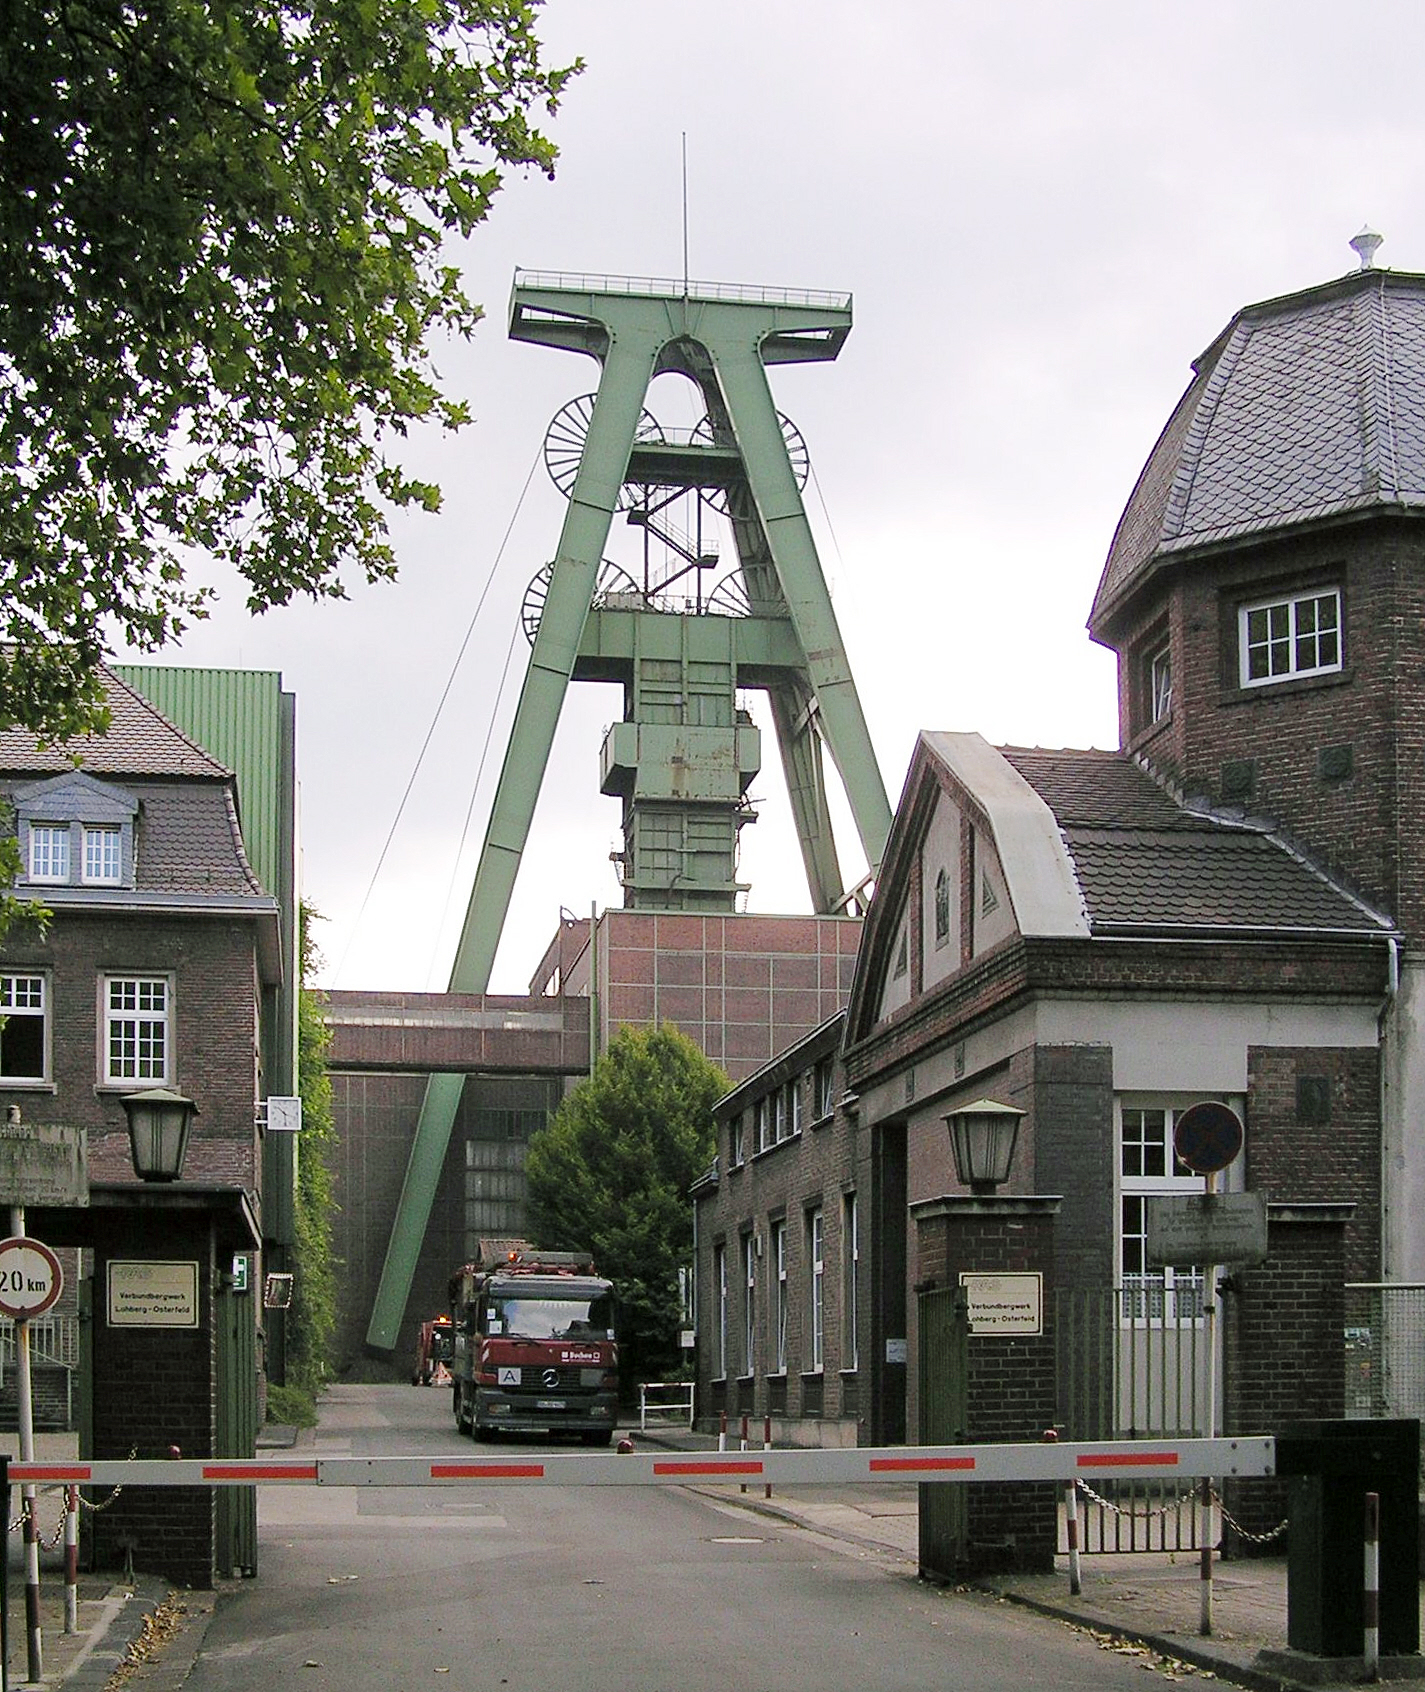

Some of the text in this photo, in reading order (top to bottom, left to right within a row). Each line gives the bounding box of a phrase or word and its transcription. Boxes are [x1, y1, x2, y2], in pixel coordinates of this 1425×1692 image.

[0, 1271, 46, 1292] 20 km
[119, 1291, 186, 1302] Verbundbergwerk
[971, 1302, 1031, 1311] Verbundbergwerk
[503, 1370, 517, 1383] A
